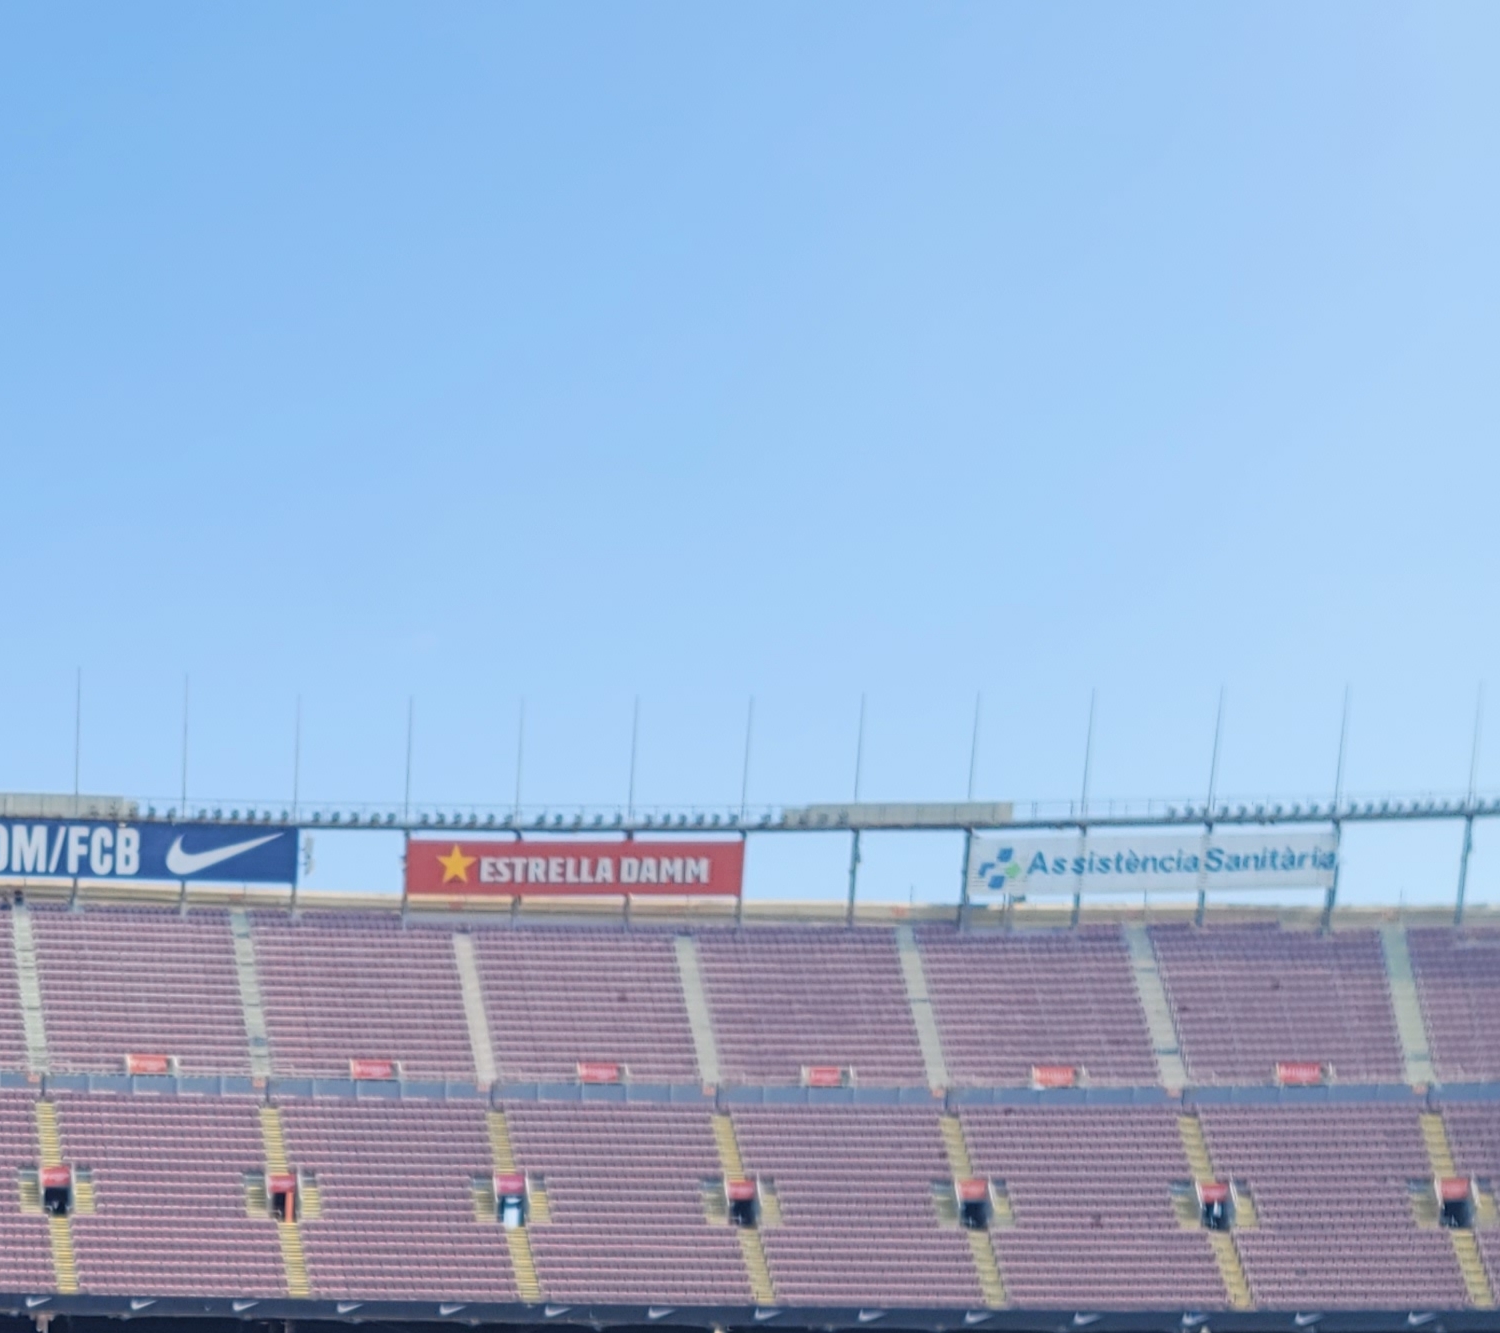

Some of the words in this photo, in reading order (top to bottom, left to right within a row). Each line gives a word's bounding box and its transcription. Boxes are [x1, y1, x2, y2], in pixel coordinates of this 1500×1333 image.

[479, 855, 614, 884] ESTRELLA
[619, 856, 710, 884] DAMM
[1027, 848, 1199, 875] Assistència
[1204, 846, 1338, 873] Sanitària
